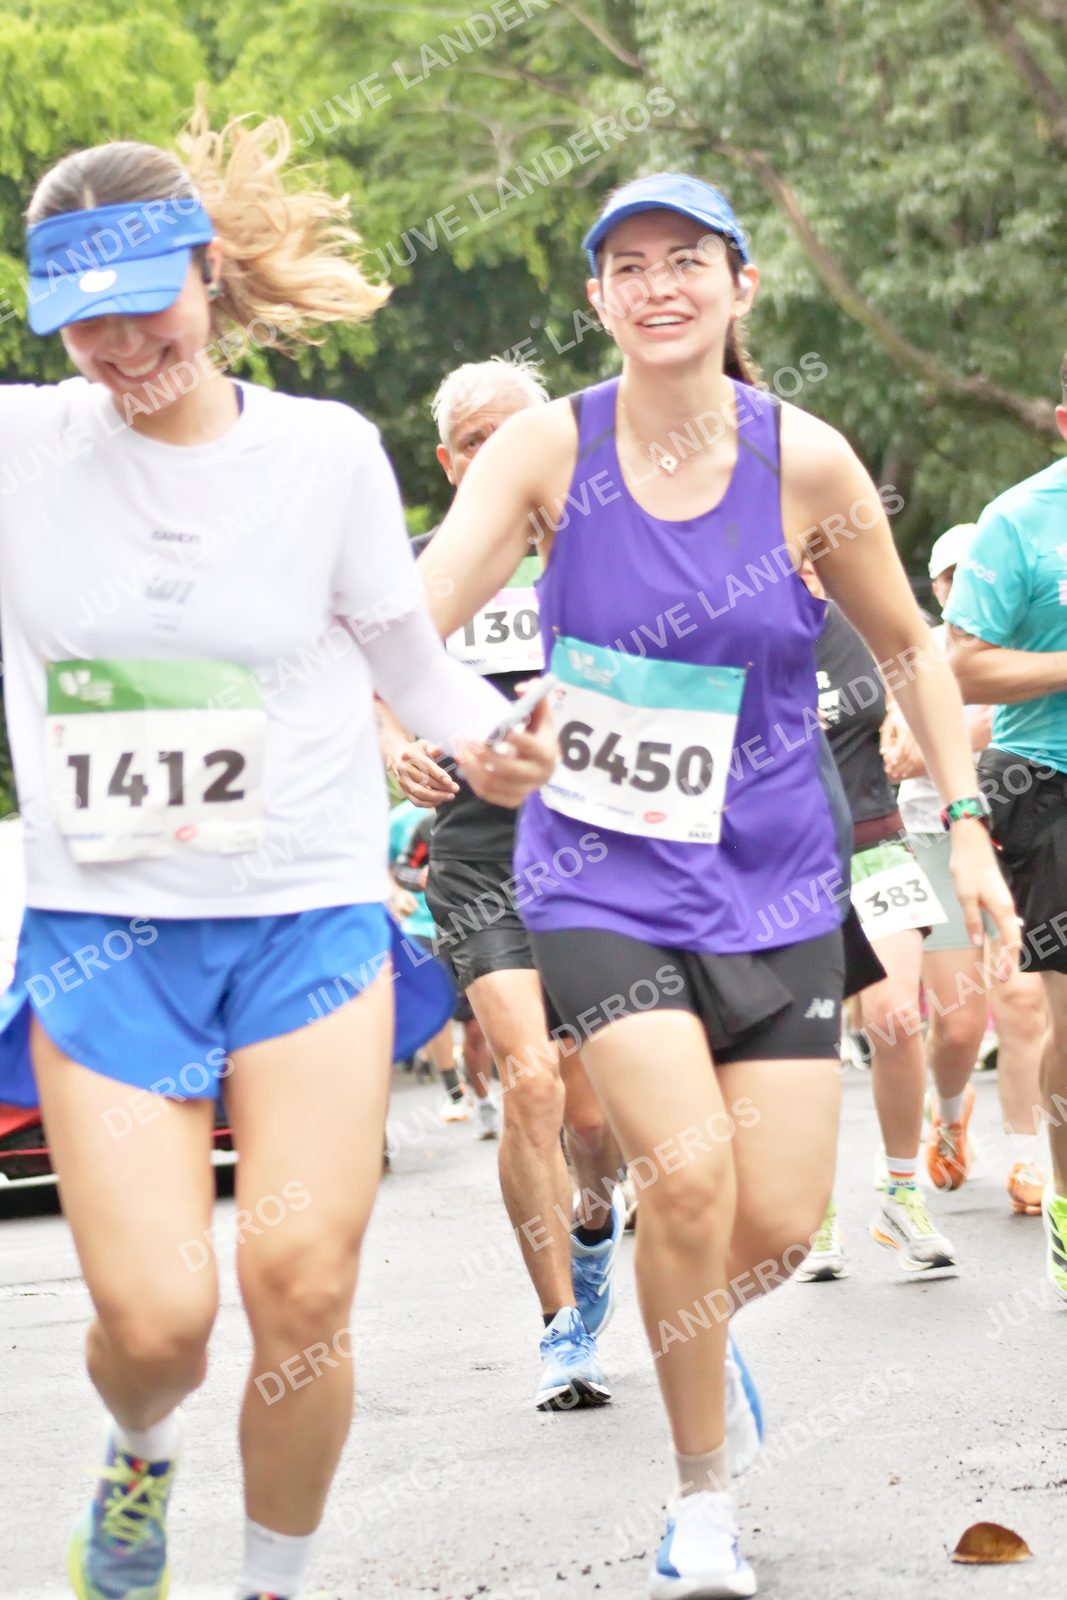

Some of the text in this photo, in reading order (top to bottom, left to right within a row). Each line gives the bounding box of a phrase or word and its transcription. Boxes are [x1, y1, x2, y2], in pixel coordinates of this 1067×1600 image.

[67, 749, 245, 809] 1412
[558, 720, 714, 796] 6450
[859, 879, 928, 920] 383
